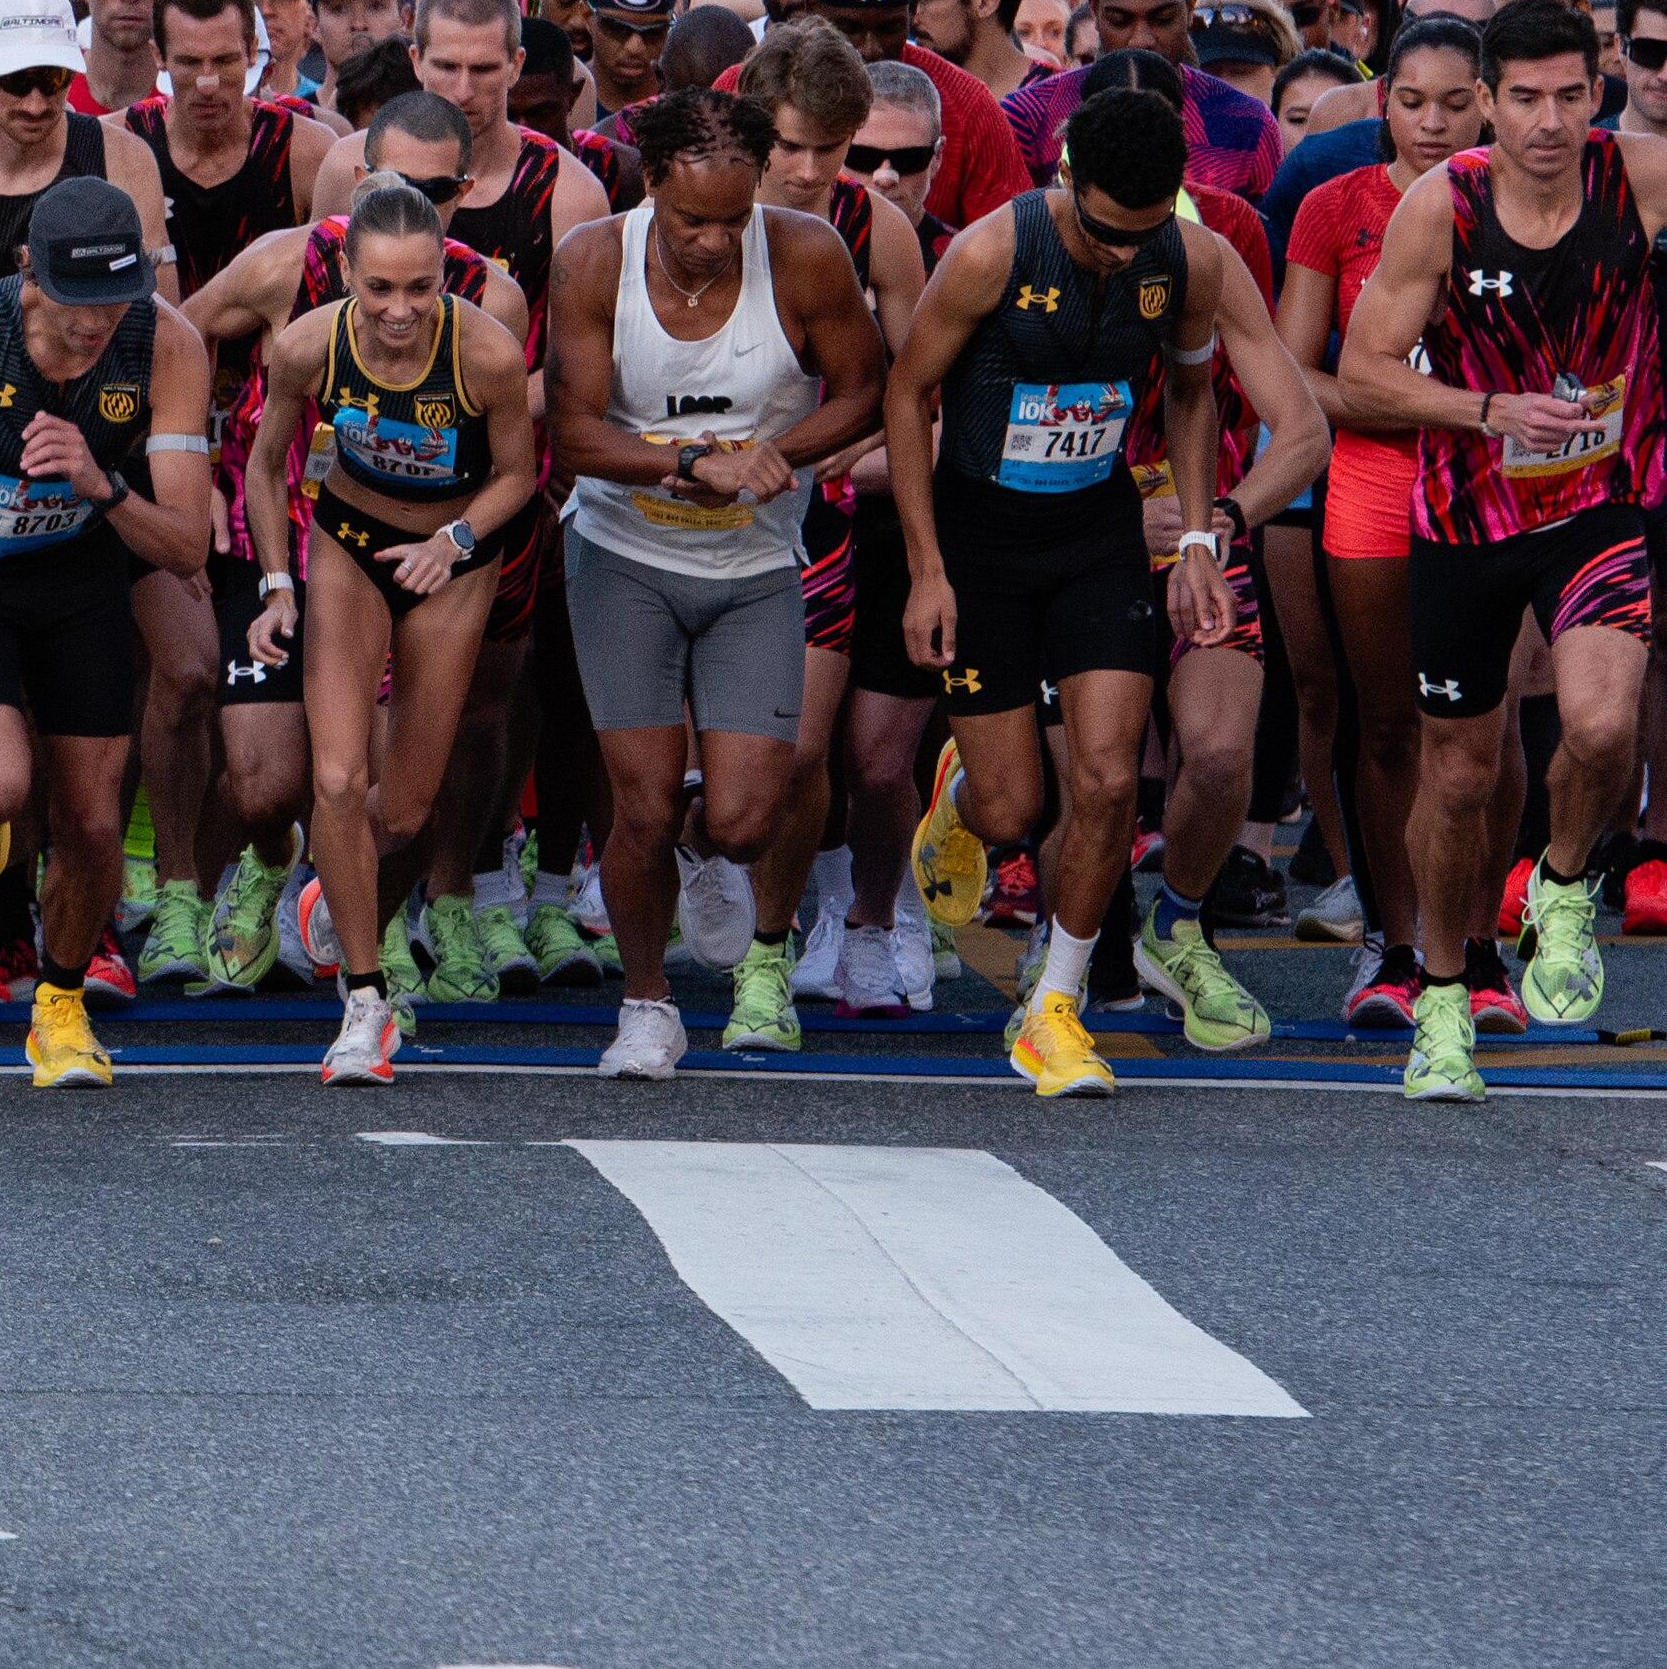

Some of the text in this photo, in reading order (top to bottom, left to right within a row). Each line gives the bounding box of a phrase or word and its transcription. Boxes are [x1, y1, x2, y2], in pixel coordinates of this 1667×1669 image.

[2, 18, 62, 29] BALTIMORE
[1018, 401, 1056, 421] 10K
[1045, 427, 1107, 459] 7417
[12, 513, 78, 535] 8703
